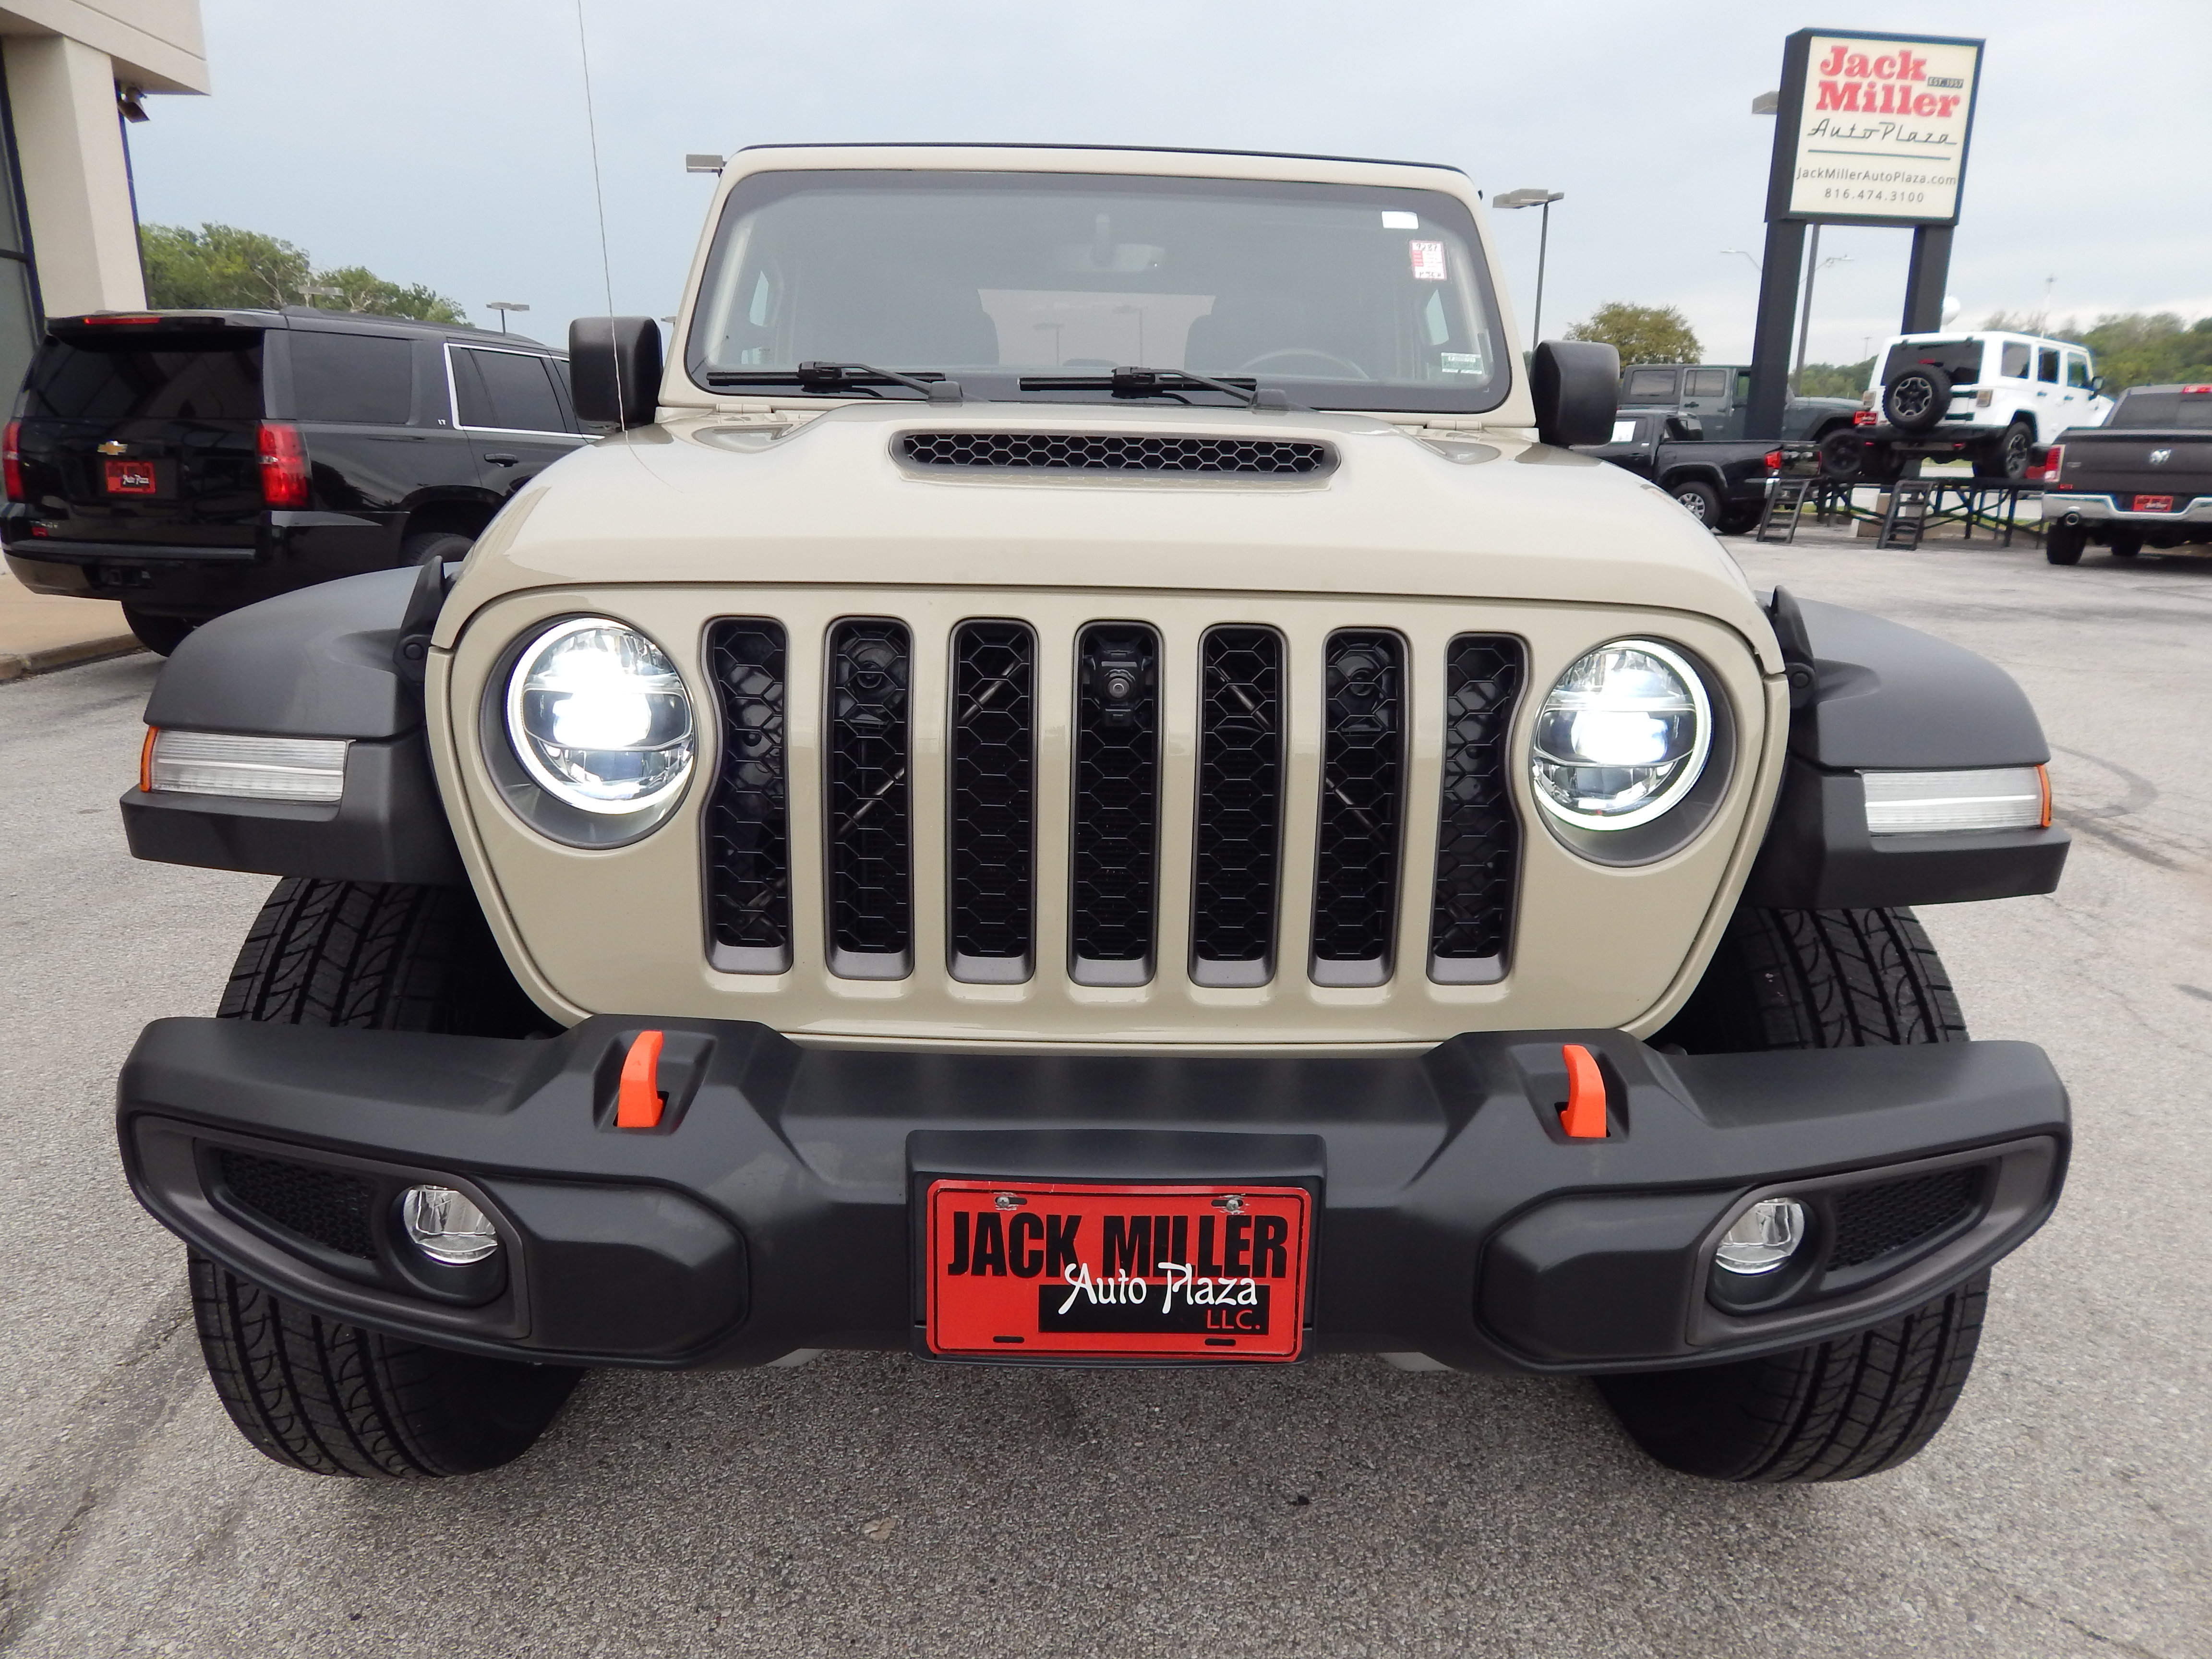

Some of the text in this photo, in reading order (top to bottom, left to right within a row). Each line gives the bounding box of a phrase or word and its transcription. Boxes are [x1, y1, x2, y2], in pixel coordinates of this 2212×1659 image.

[1820, 45, 1927, 81] Jack
[1815, 80, 1960, 118] Miller
[1807, 118, 1957, 145] Auto Plaza
[1796, 167, 1956, 185] JackMillerAutoPlaza.com
[1824, 188, 1924, 203] 816.474.3100
[948, 1211, 1288, 1279] JACK MILLER
[1058, 1262, 1258, 1314] Auto Plaza
[1207, 1310, 1261, 1330] LLC.
